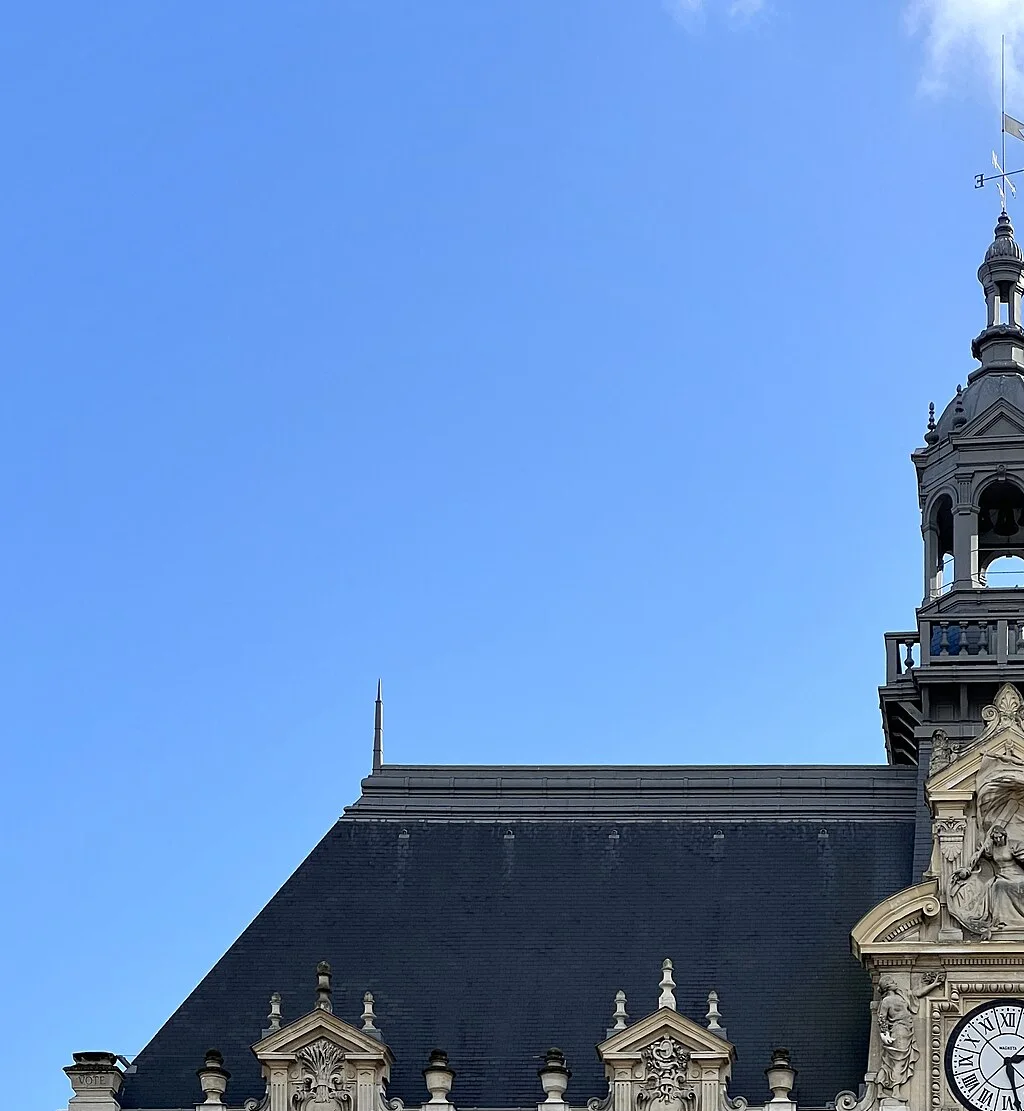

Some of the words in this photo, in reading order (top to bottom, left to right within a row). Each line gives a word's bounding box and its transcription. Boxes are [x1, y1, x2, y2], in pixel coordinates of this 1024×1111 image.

[978, 1017, 995, 1035] XI
[1000, 1013, 1015, 1027] XII
[964, 1034, 980, 1048] X
[959, 1055, 973, 1066] IX
[962, 1074, 980, 1092] VIII
[978, 1088, 994, 1107] VII
[1002, 1096, 1014, 1110] VI
